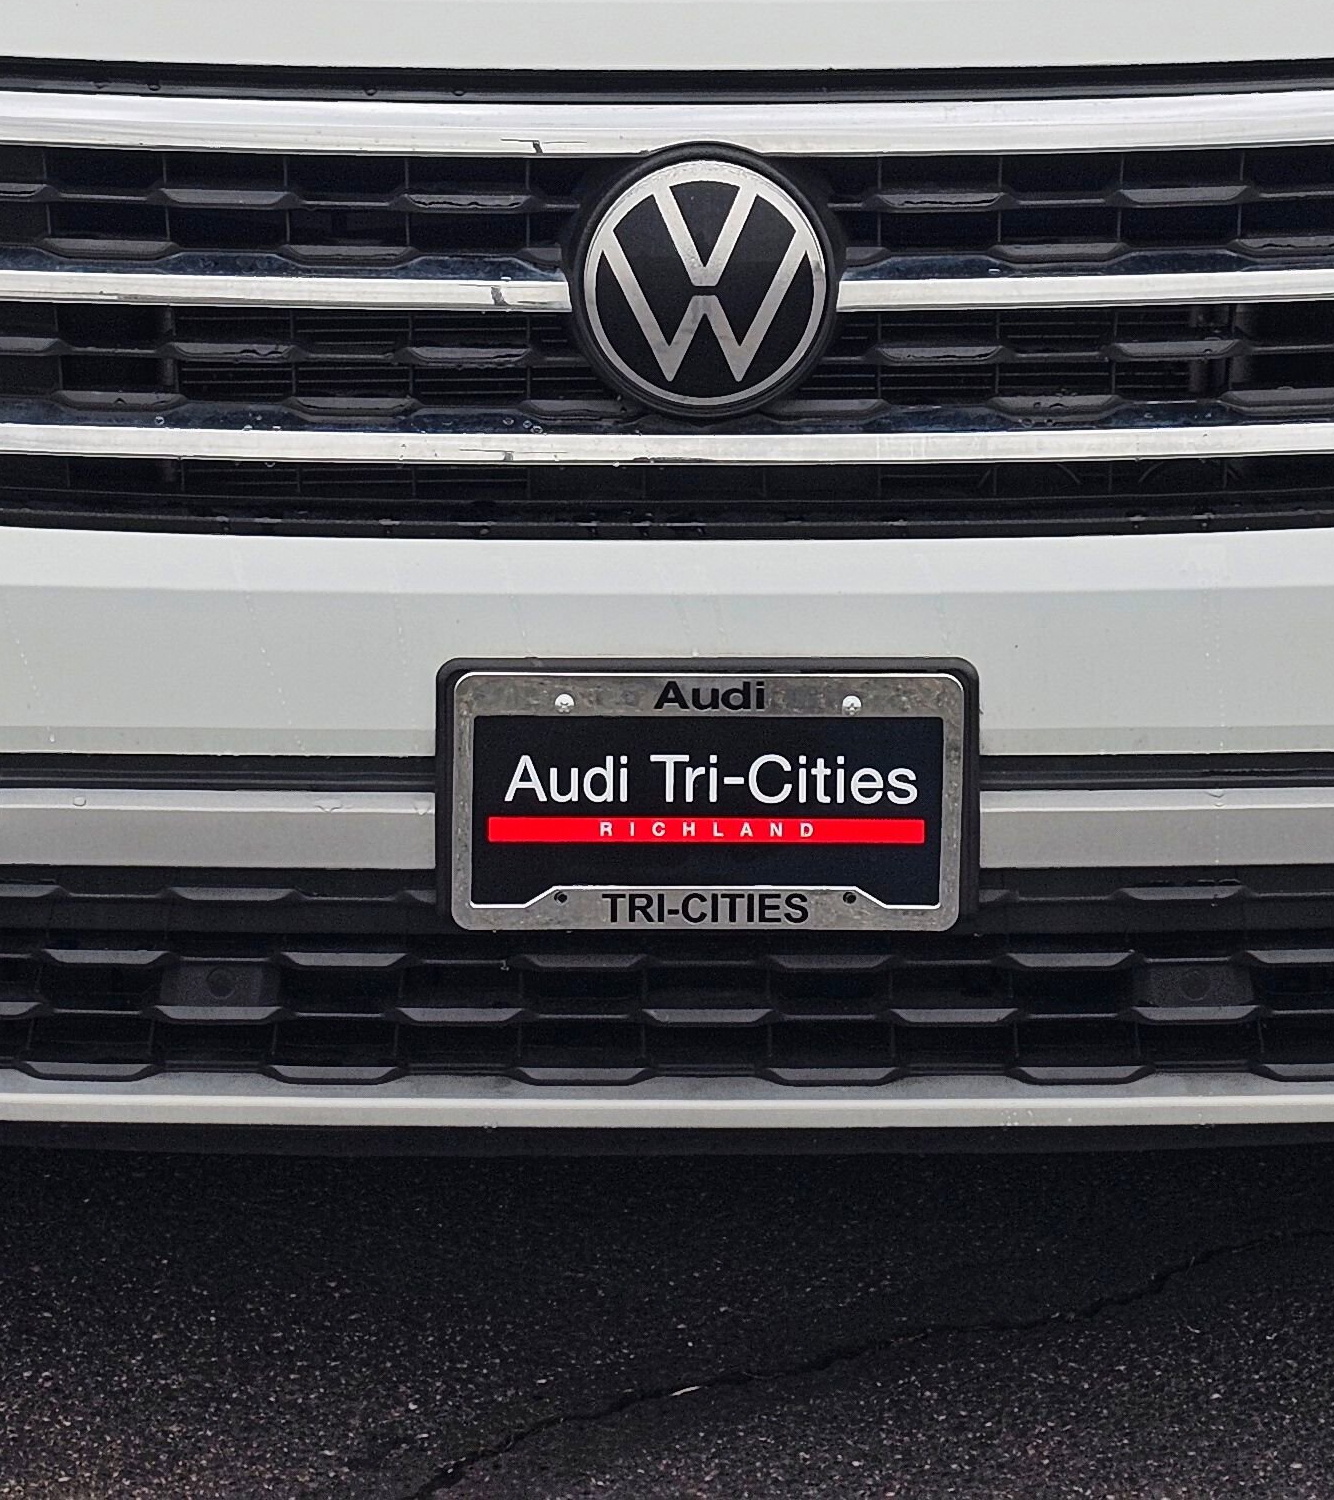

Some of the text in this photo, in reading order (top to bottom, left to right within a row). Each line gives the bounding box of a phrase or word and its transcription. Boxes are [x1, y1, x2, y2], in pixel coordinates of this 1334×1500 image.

[654, 680, 765, 710] Audi
[504, 754, 918, 804] Audi Tri-Cities
[600, 822, 815, 838] RICHLAND
[602, 893, 809, 924] TRI-CITIES
